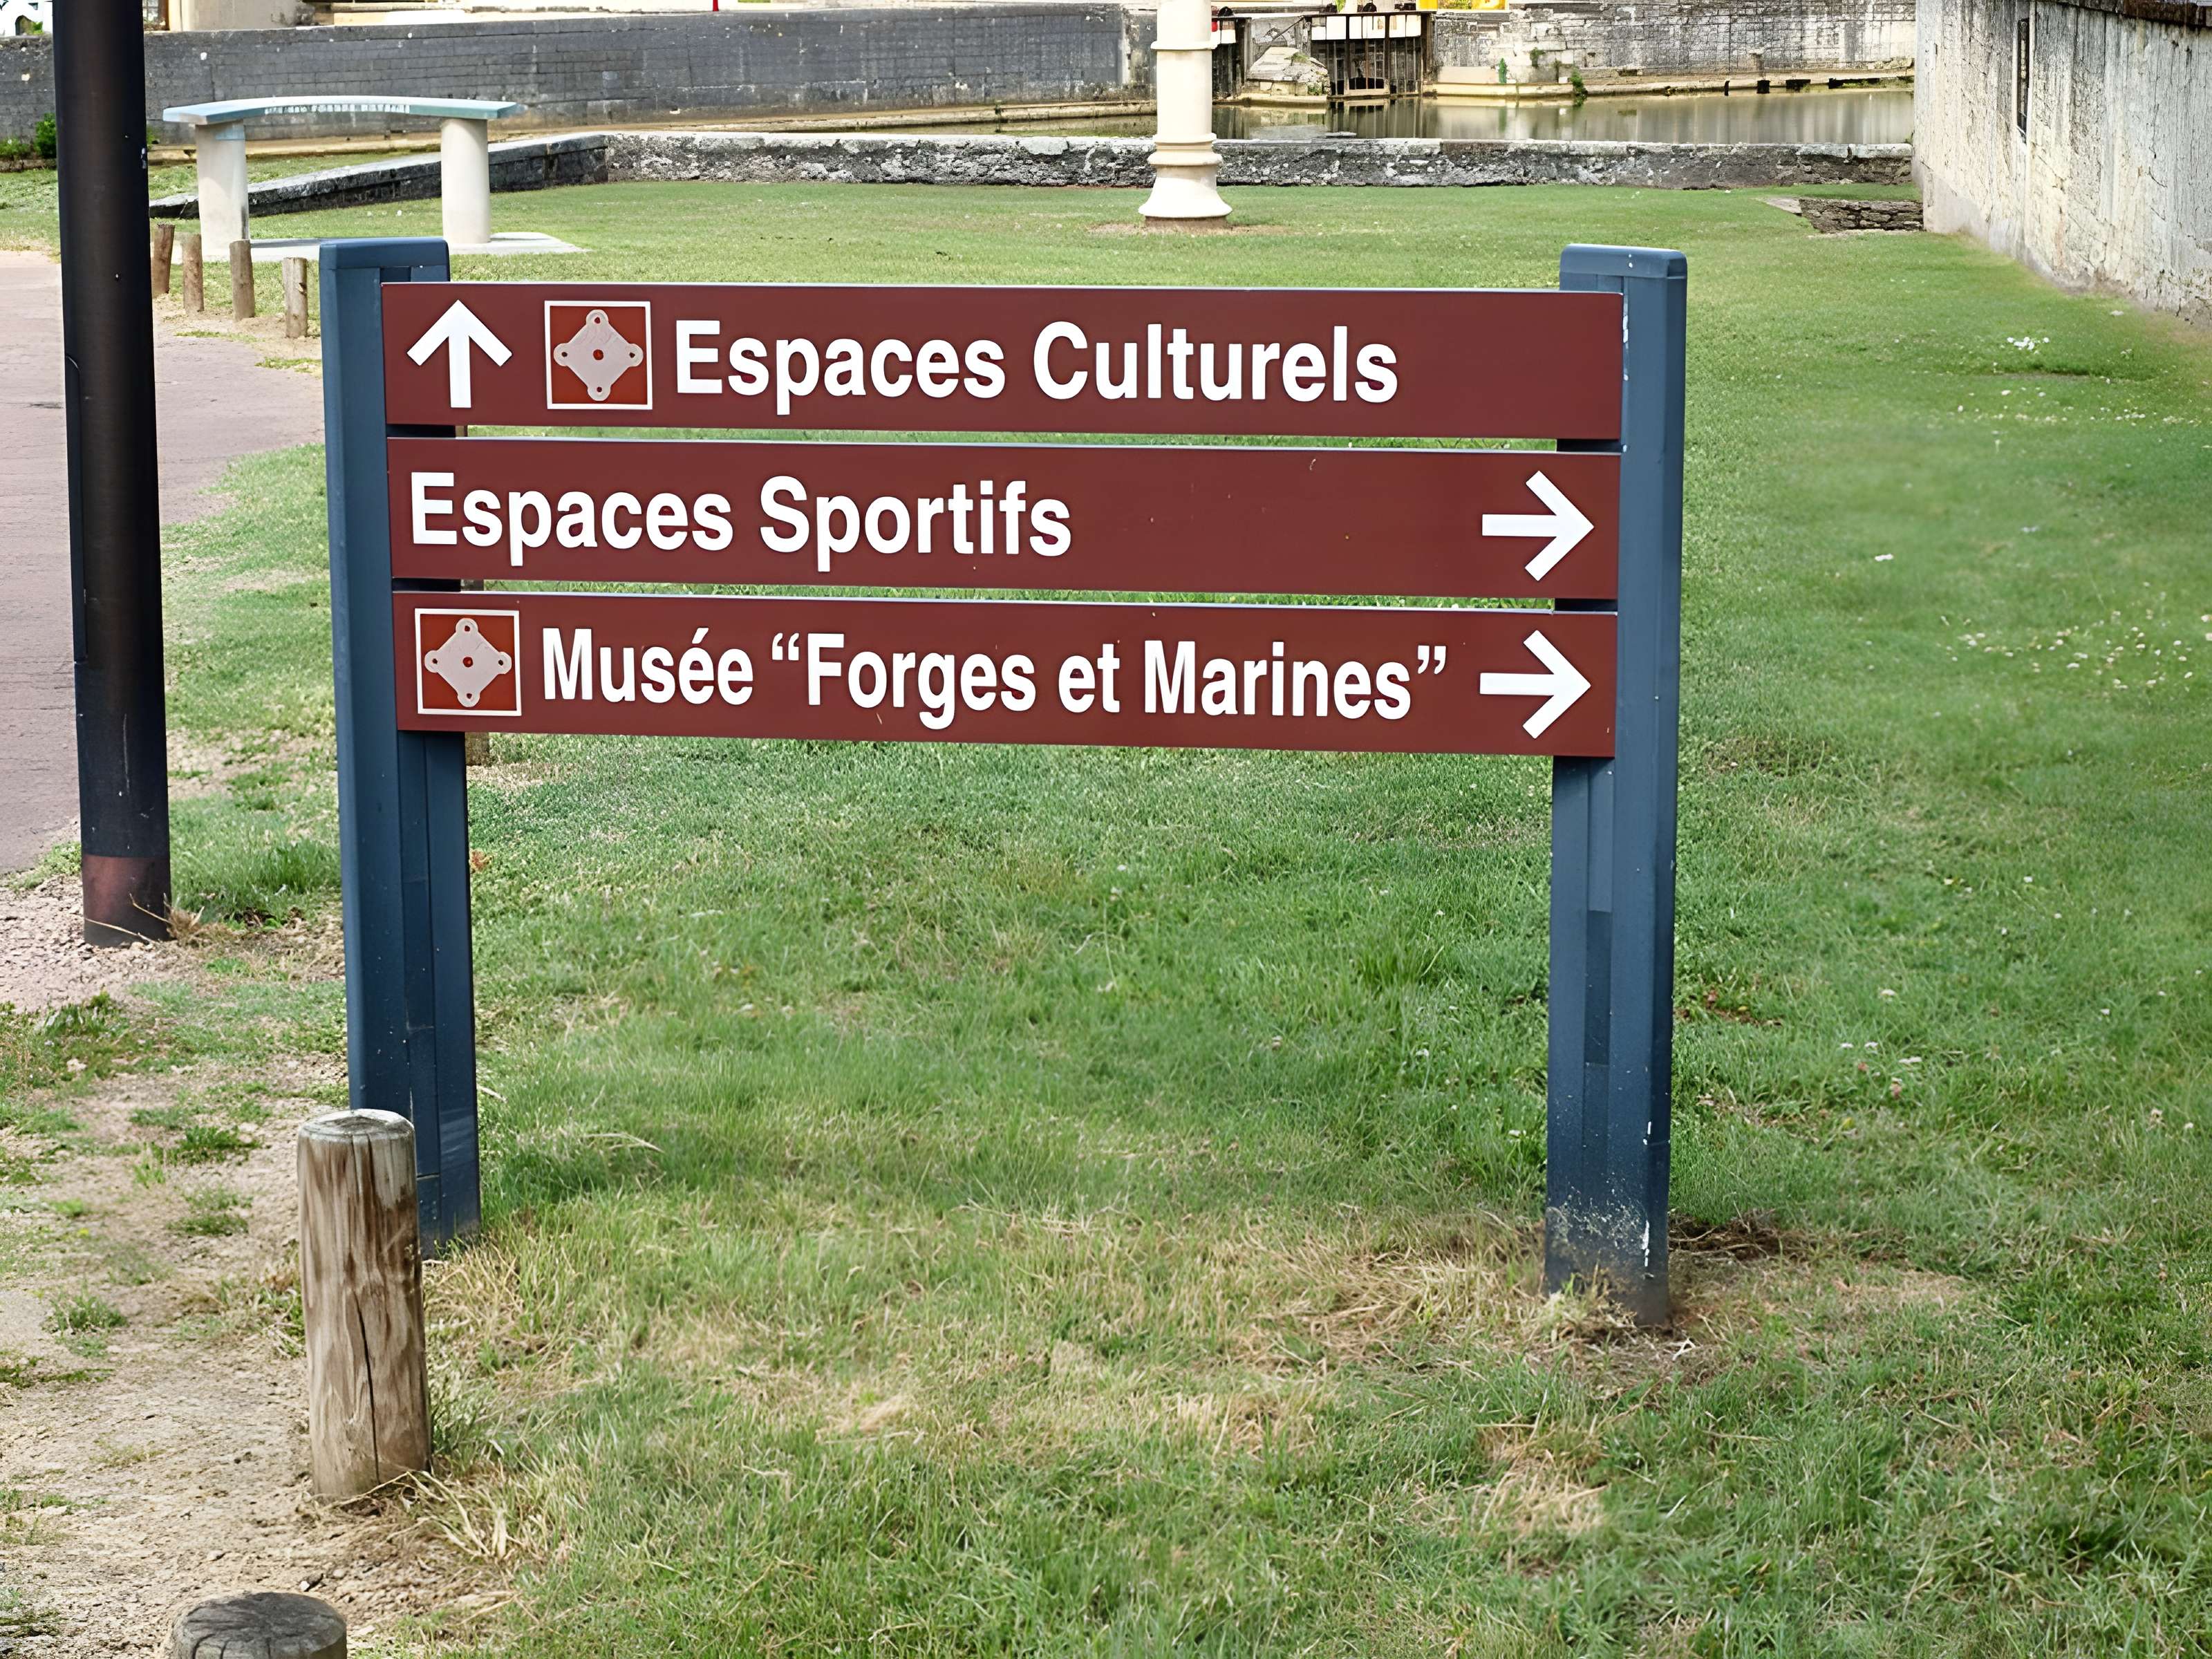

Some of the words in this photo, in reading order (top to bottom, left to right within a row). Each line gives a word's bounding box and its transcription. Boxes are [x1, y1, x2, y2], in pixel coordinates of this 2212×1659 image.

[676, 320, 1006, 415] Espaces
[1033, 321, 1398, 404] Culturels
[411, 471, 734, 567] Espaces
[760, 476, 1072, 572] Sportifs
[543, 627, 754, 707] Musée
[771, 632, 1037, 730] “Forges
[1058, 644, 1121, 713] et
[1145, 640, 1447, 720] Marines”
